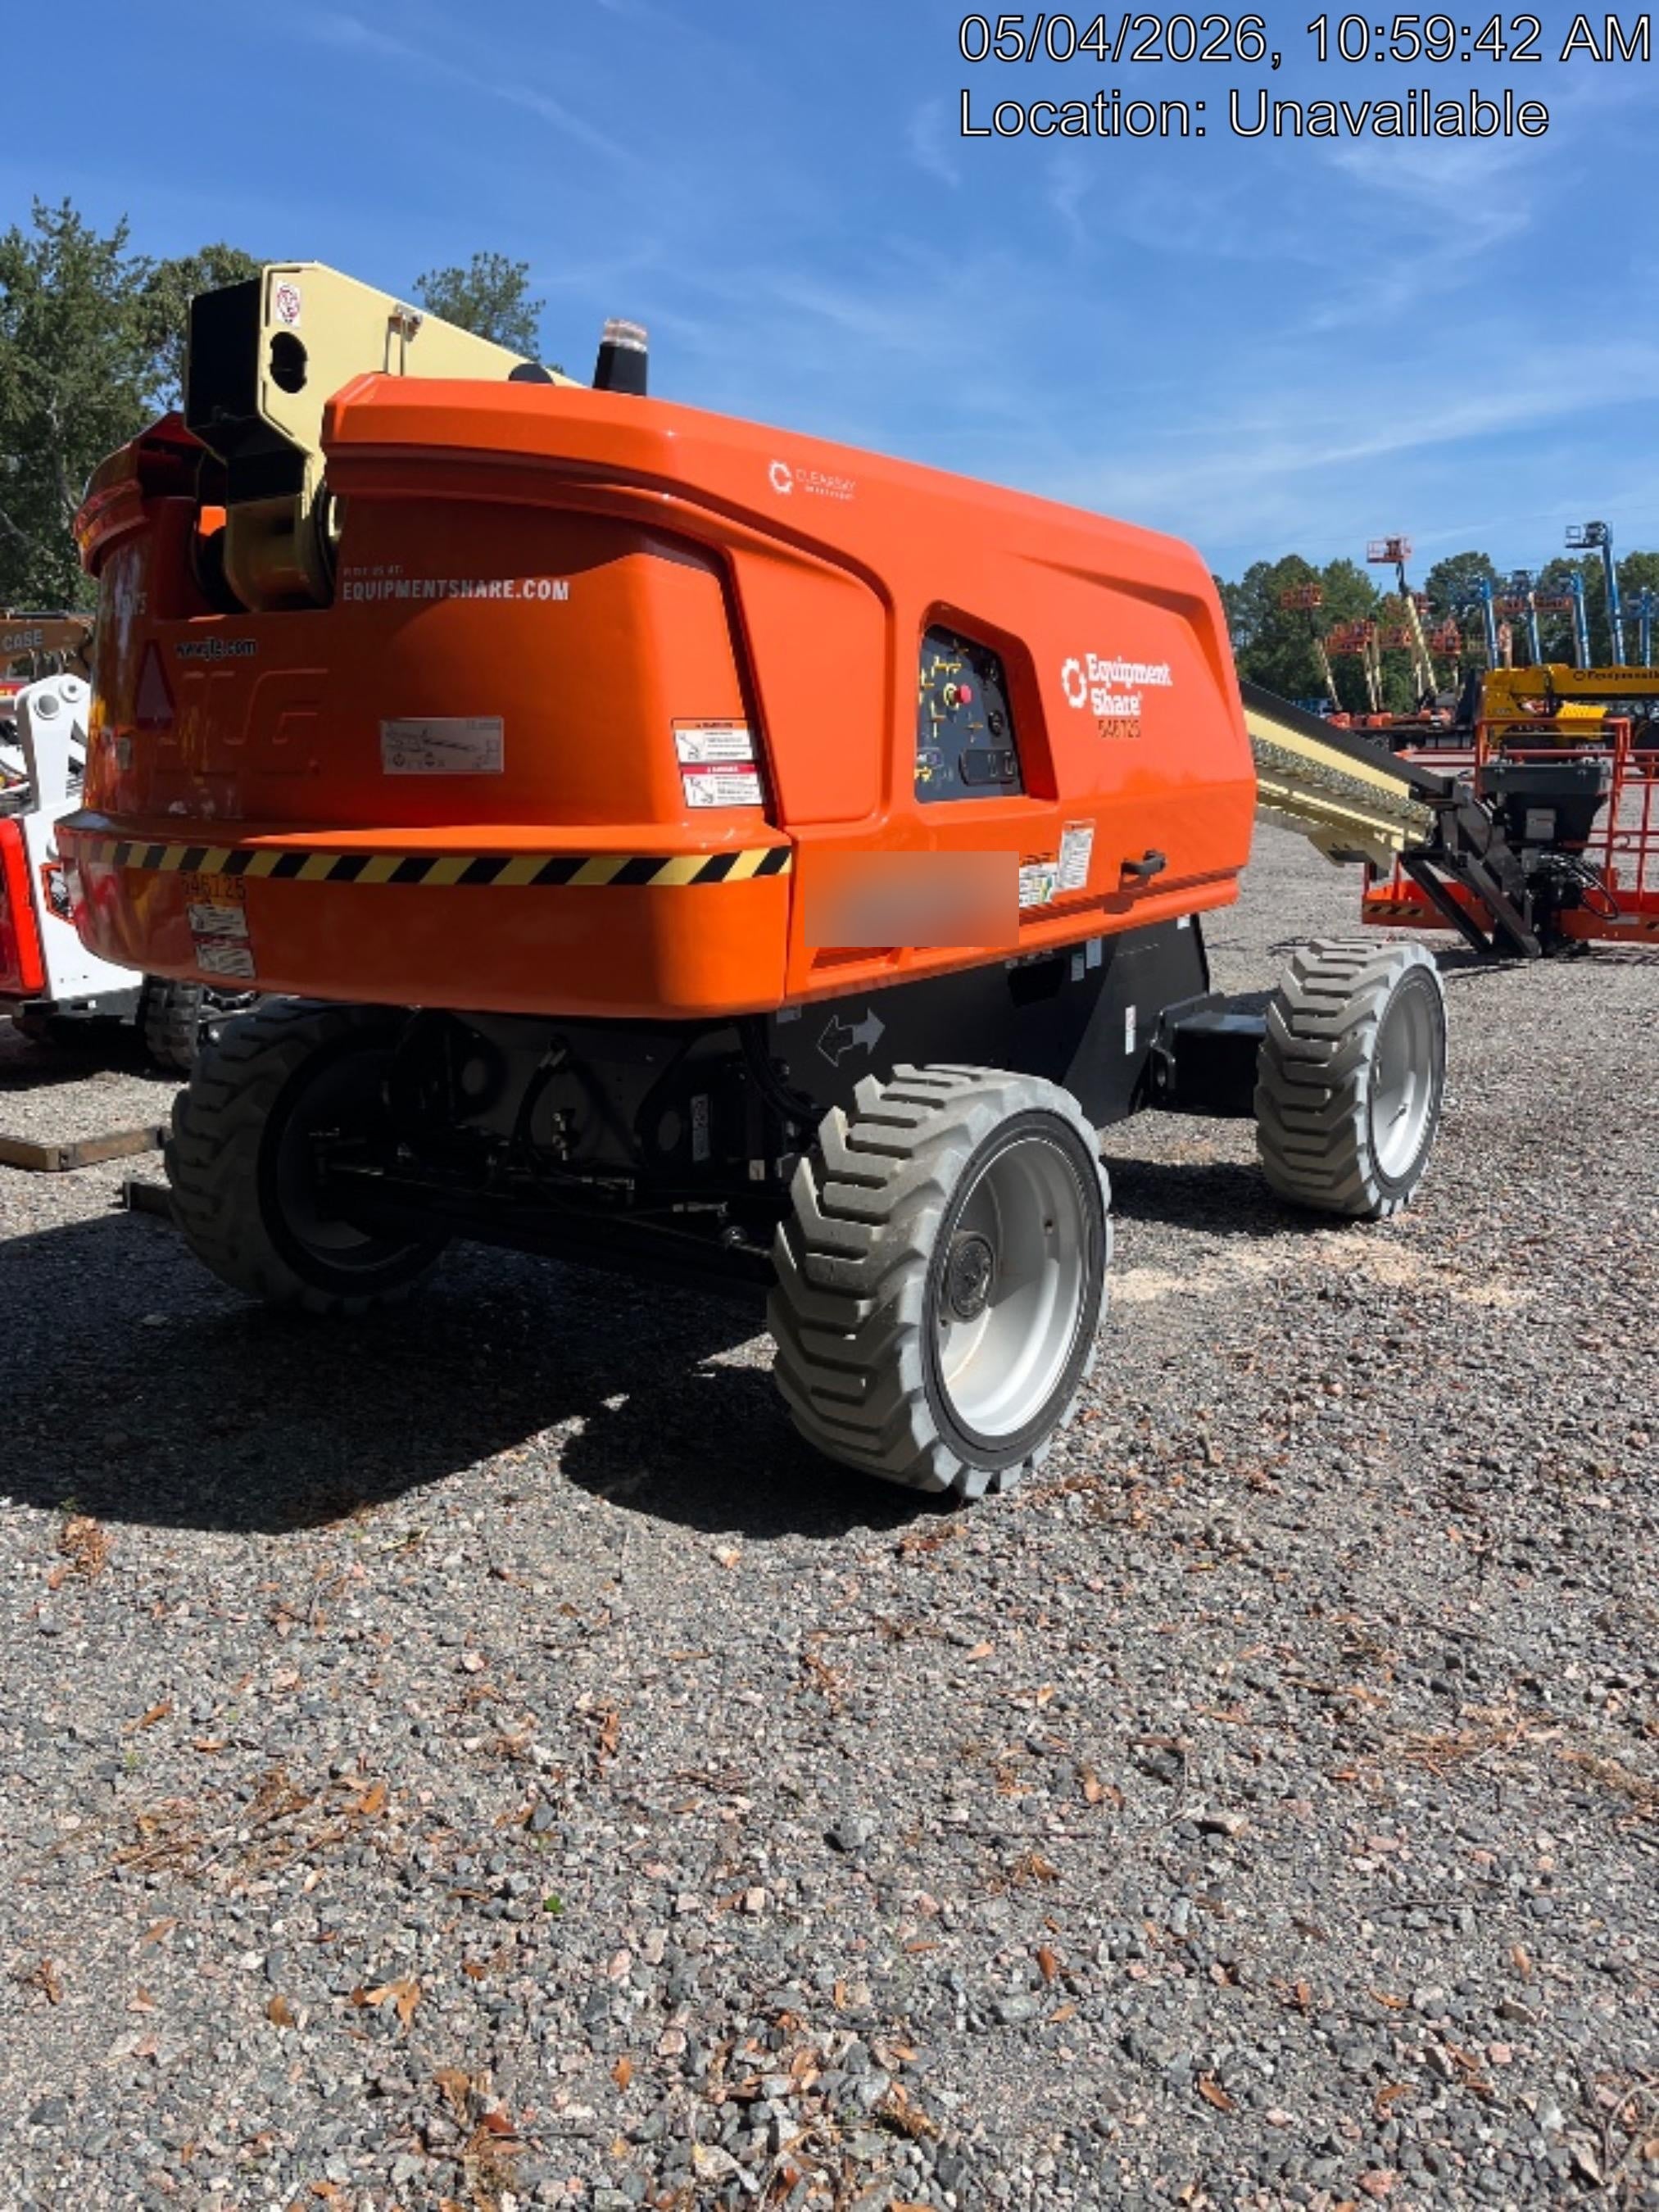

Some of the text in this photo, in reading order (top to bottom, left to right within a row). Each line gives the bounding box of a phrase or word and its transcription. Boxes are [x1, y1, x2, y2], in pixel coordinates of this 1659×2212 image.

[342, 578, 569, 601] EQUIPMENTSHARE.COM
[3, 628, 43, 651] CASE
[1085, 653, 1173, 689] Equipment
[1090, 687, 1142, 716] Share
